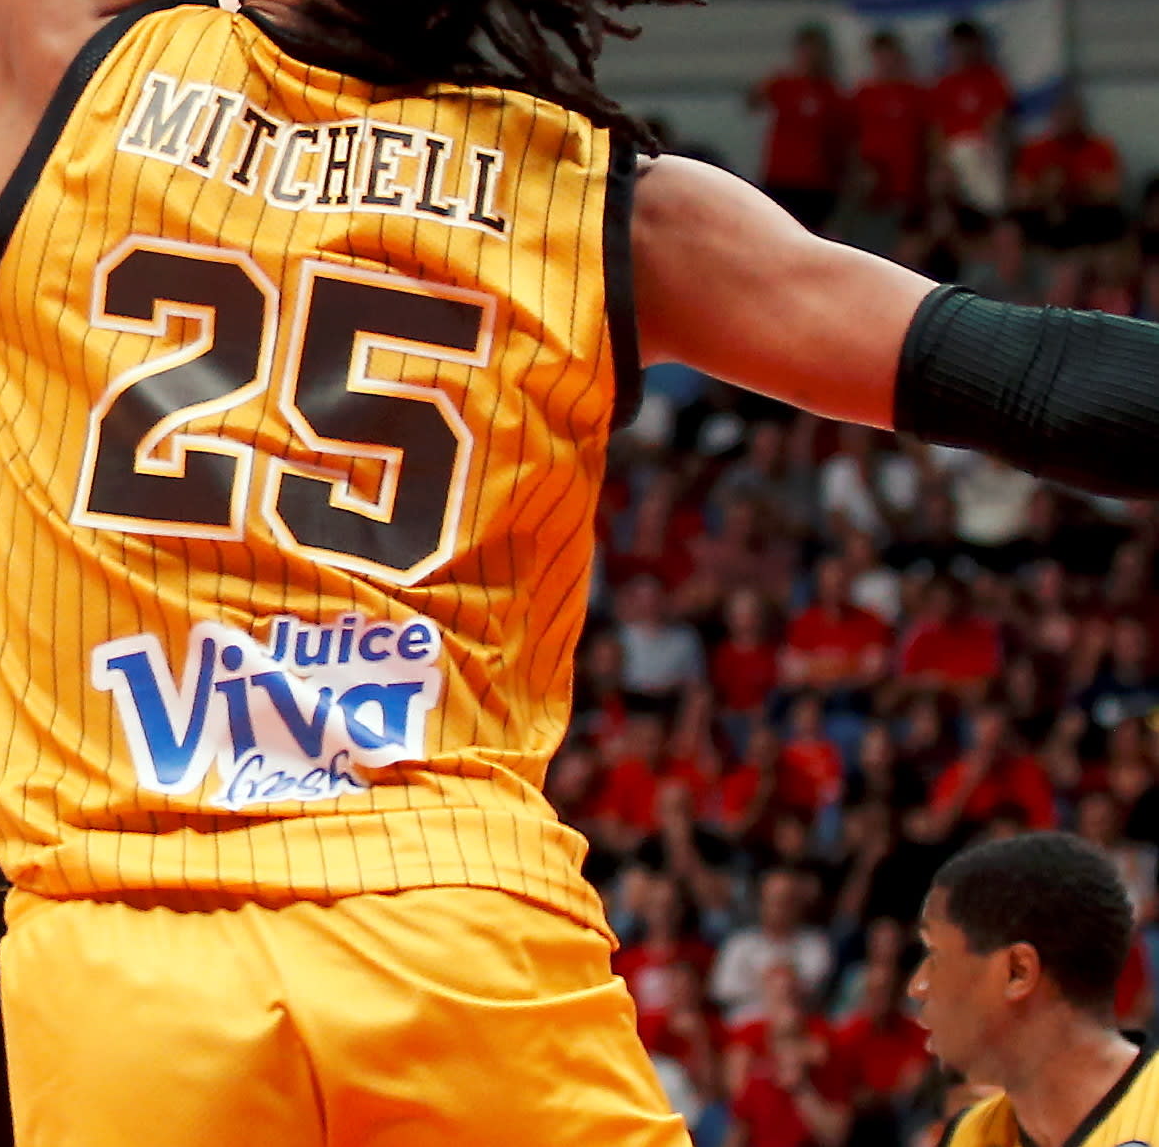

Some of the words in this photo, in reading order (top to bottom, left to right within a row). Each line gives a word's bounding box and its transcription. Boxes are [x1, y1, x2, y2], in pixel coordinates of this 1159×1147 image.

[118, 71, 507, 240] MITCHELL
[71, 235, 497, 586] 25
[107, 637, 424, 785] Viva
[270, 616, 432, 667] Juice
